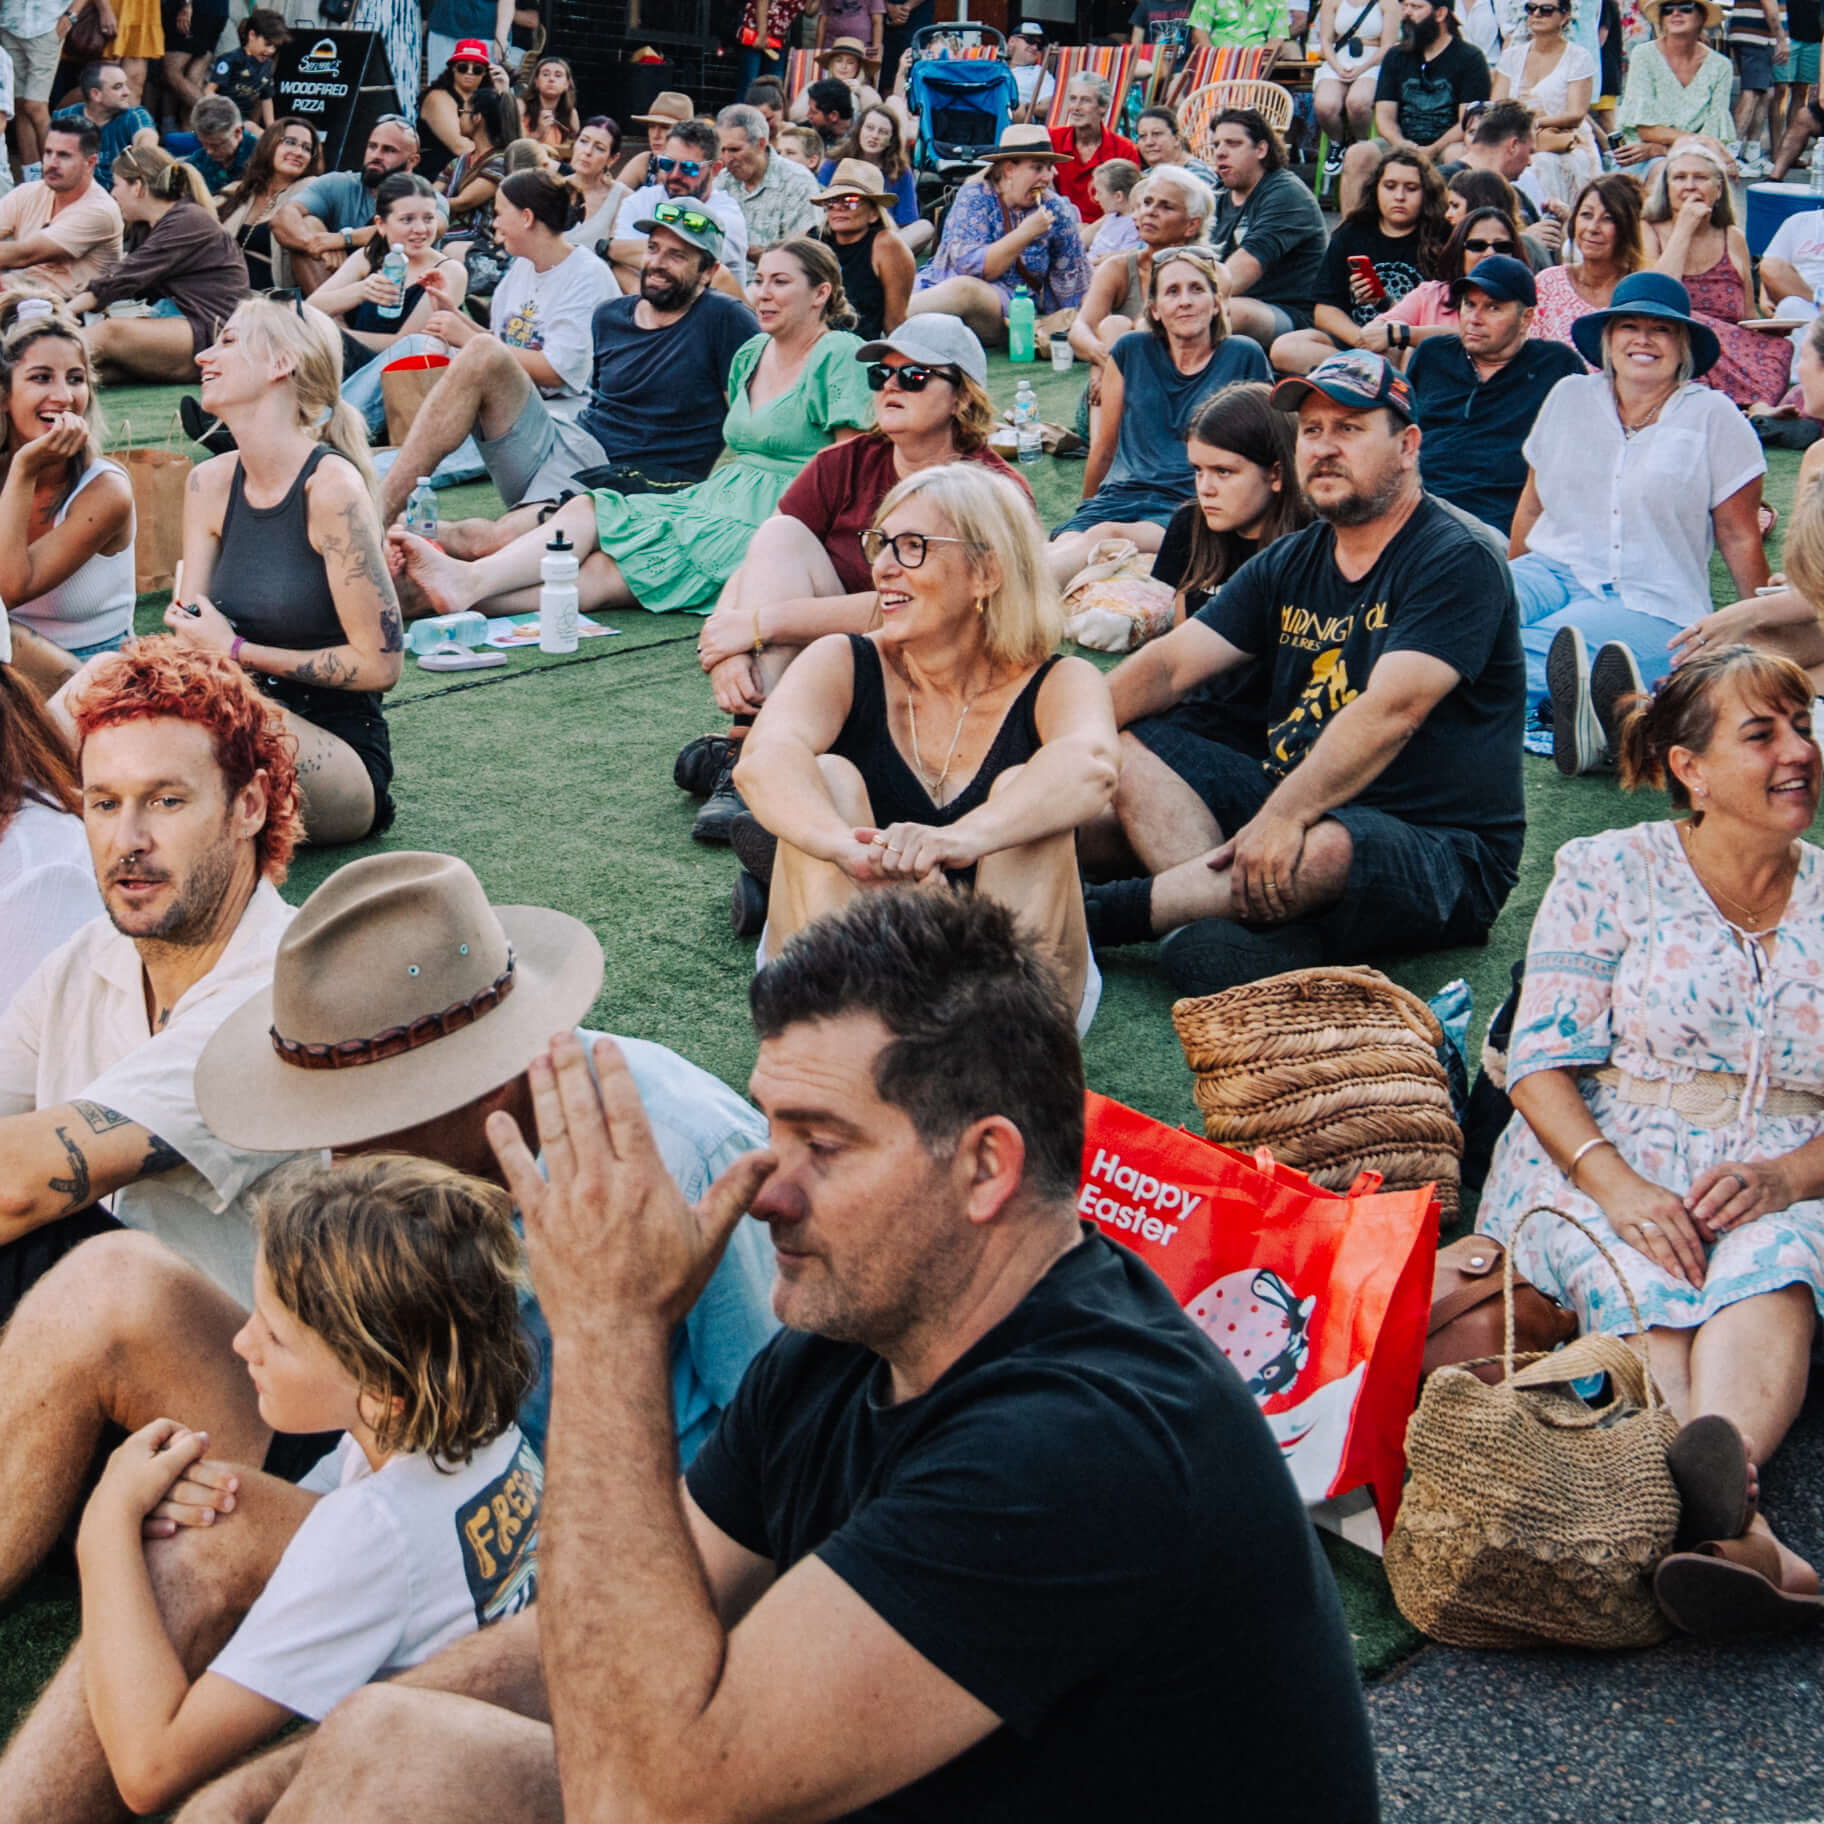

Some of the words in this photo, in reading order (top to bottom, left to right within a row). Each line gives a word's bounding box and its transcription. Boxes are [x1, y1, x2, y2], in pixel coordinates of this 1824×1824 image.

[280, 81, 348, 97] WOODFIRED
[291, 98, 325, 113] PIZZA
[1090, 1148, 1202, 1221] Happy
[1078, 1183, 1179, 1247] Easter
